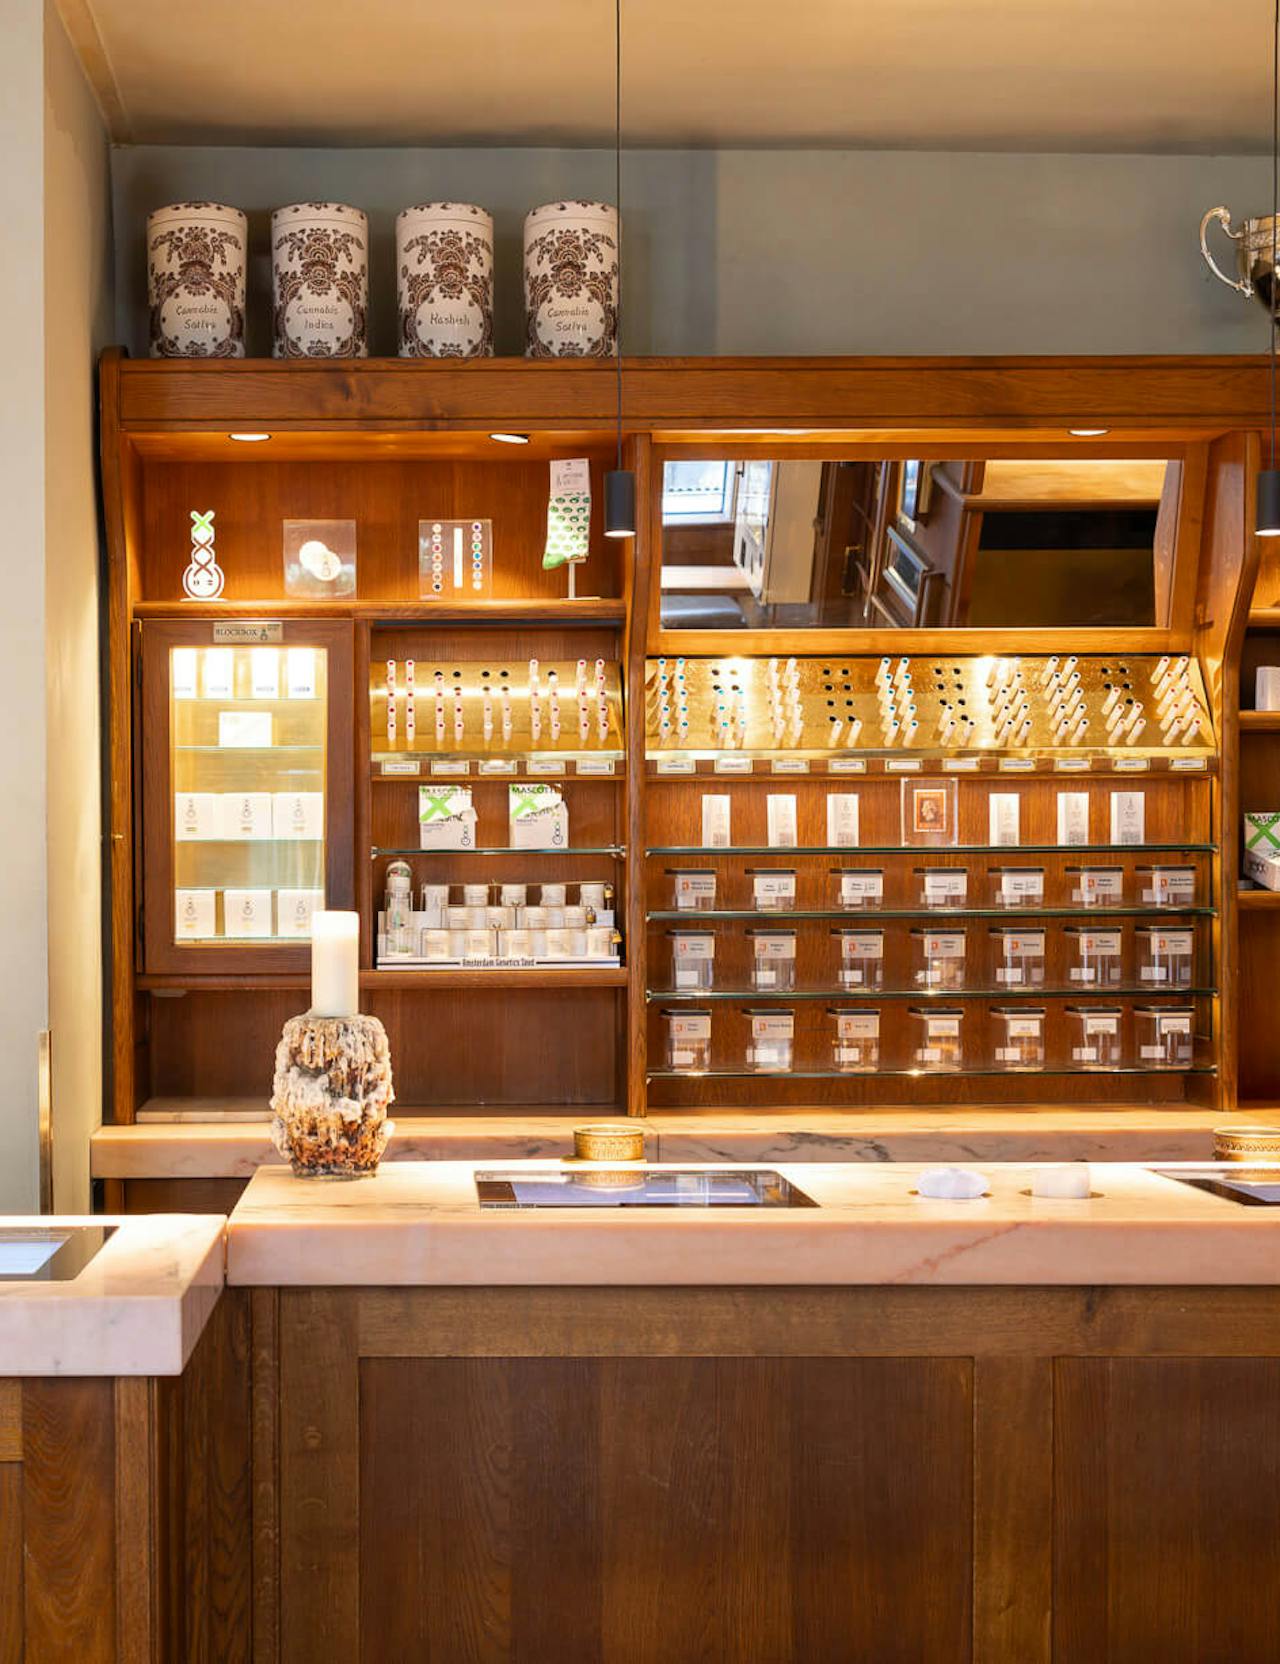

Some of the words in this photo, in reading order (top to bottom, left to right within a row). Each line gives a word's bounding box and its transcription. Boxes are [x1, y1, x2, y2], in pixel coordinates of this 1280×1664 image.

[175, 303, 218, 316] Cannabis
[296, 303, 339, 315] Cannabis
[547, 305, 590, 318] Cannabis
[303, 318, 335, 330] Indica
